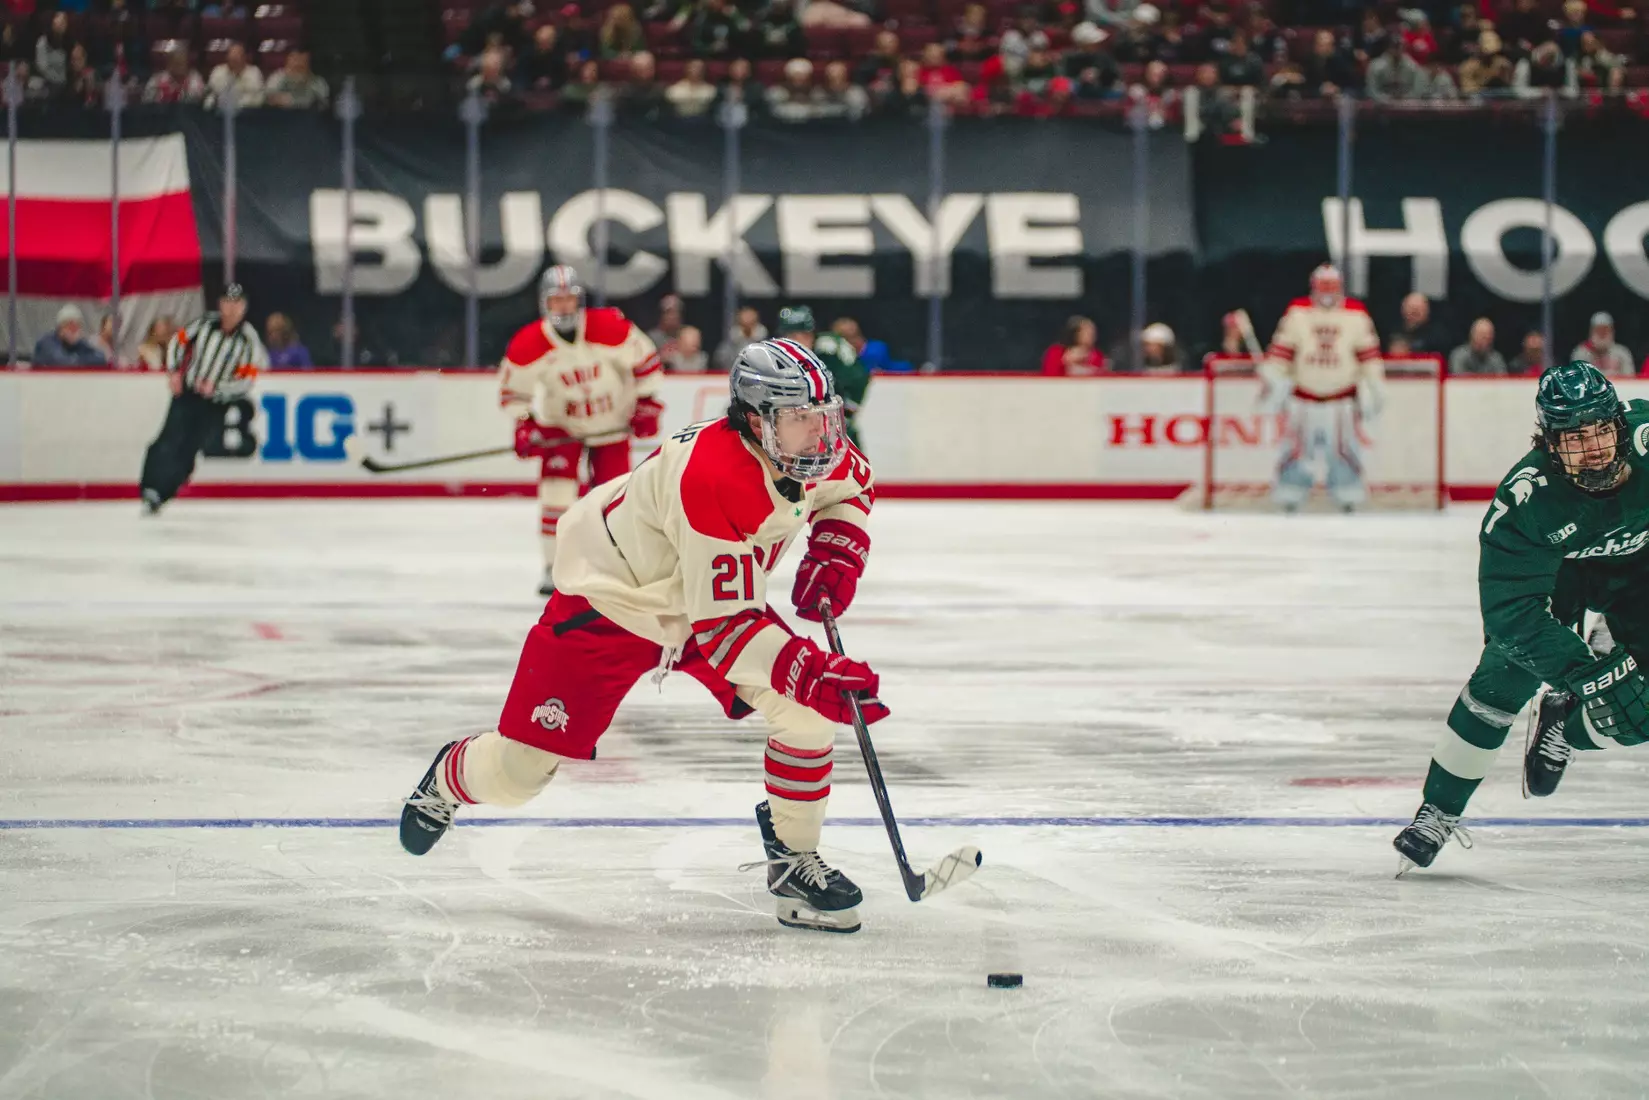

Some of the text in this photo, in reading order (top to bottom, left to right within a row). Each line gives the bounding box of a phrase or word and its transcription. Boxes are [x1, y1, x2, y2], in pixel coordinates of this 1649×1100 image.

[309, 188, 1084, 299] BUCKEYE
[1106, 413, 1372, 447] HON
[1485, 498, 1509, 534] 7
[711, 554, 755, 601] 21
